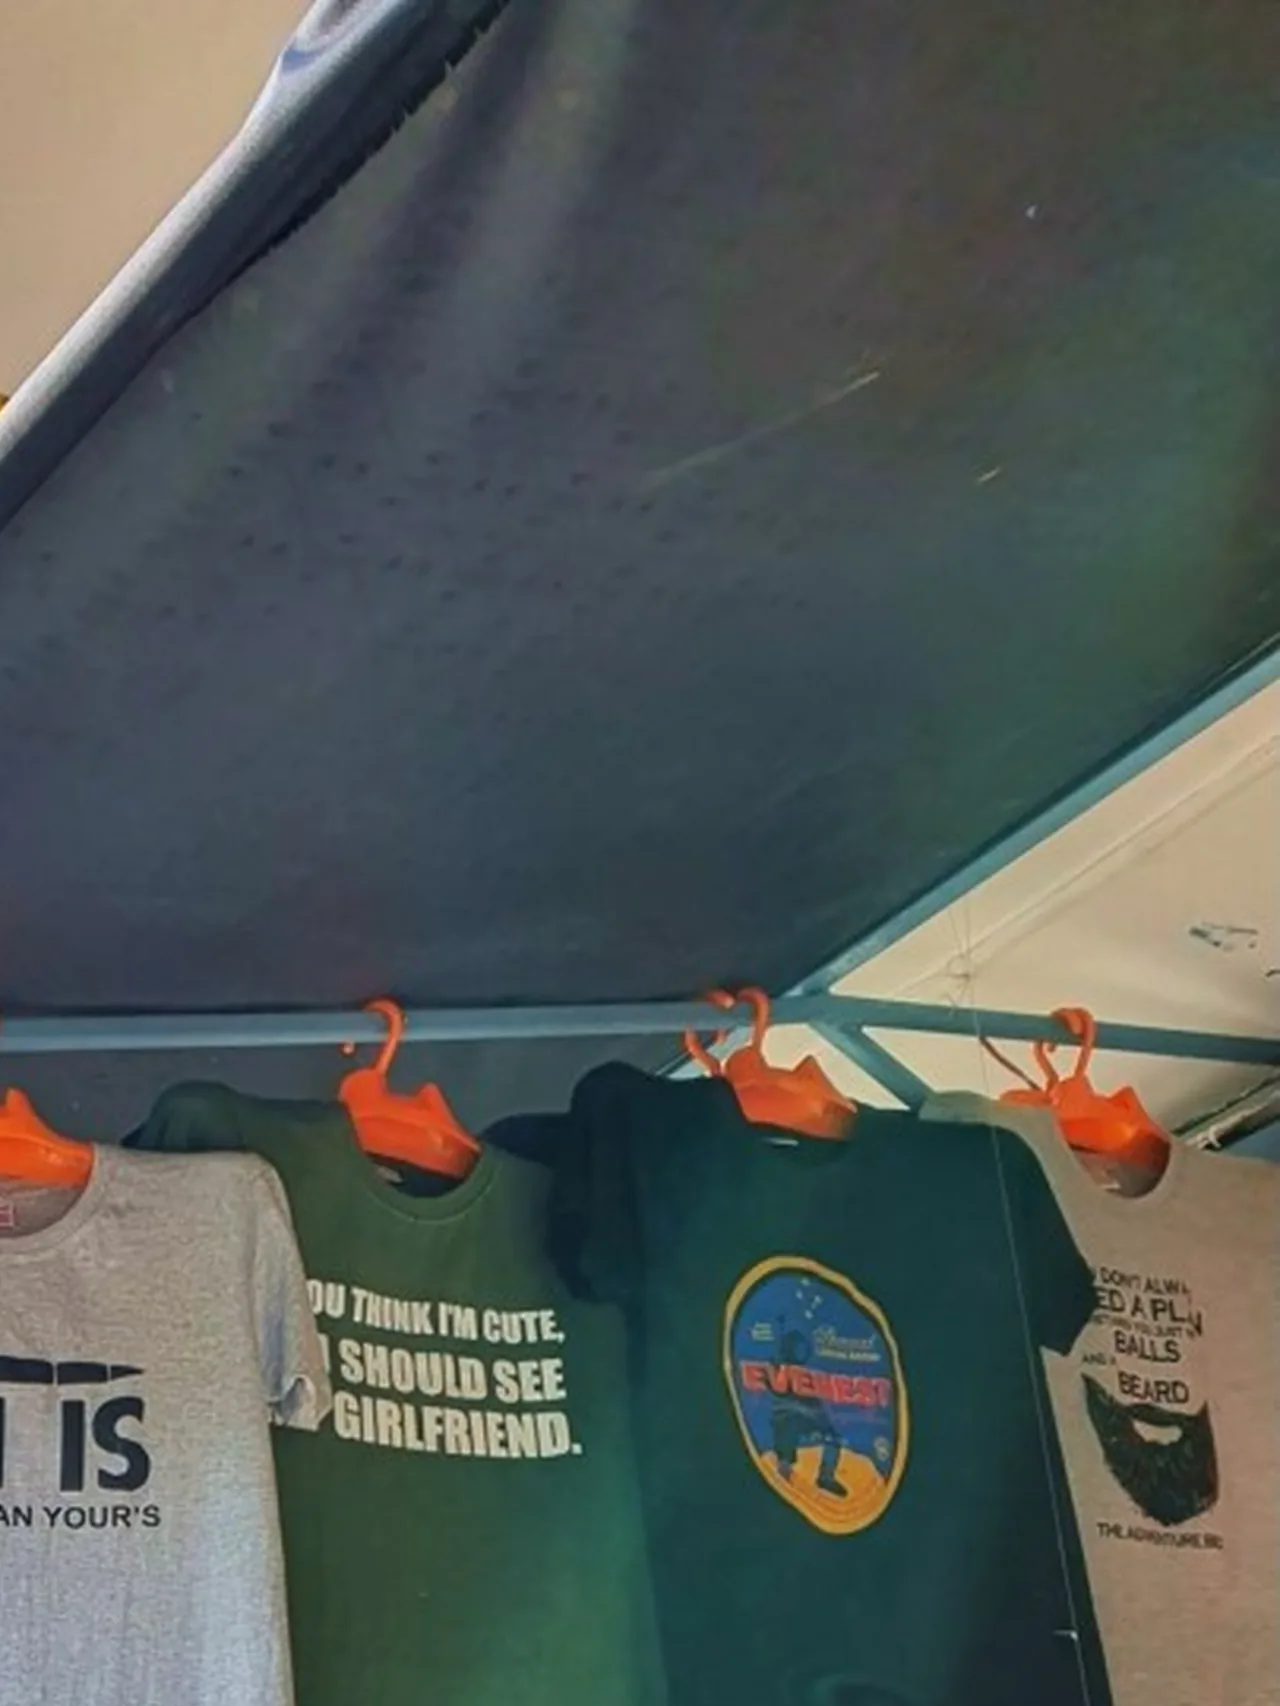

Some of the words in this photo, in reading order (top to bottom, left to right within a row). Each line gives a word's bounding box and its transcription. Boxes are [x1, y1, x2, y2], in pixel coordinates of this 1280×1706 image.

[307, 1279, 346, 1319] OU
[351, 1287, 434, 1335] THINK
[439, 1302, 478, 1341] I'M
[482, 1309, 566, 1345] CUTE,
[1095, 1286, 1125, 1312] ED
[1131, 1295, 1147, 1318] A
[1114, 1329, 1181, 1363] BALLS
[338, 1338, 488, 1401] SHOULD
[492, 1358, 567, 1404] SEE
[741, 1362, 892, 1408] EVEREST
[1117, 1370, 1190, 1404] BEARD
[60, 1396, 152, 1492] IS
[333, 1390, 583, 1460] GIRLFRIEND.
[43, 1504, 162, 1530] YOUR'S
